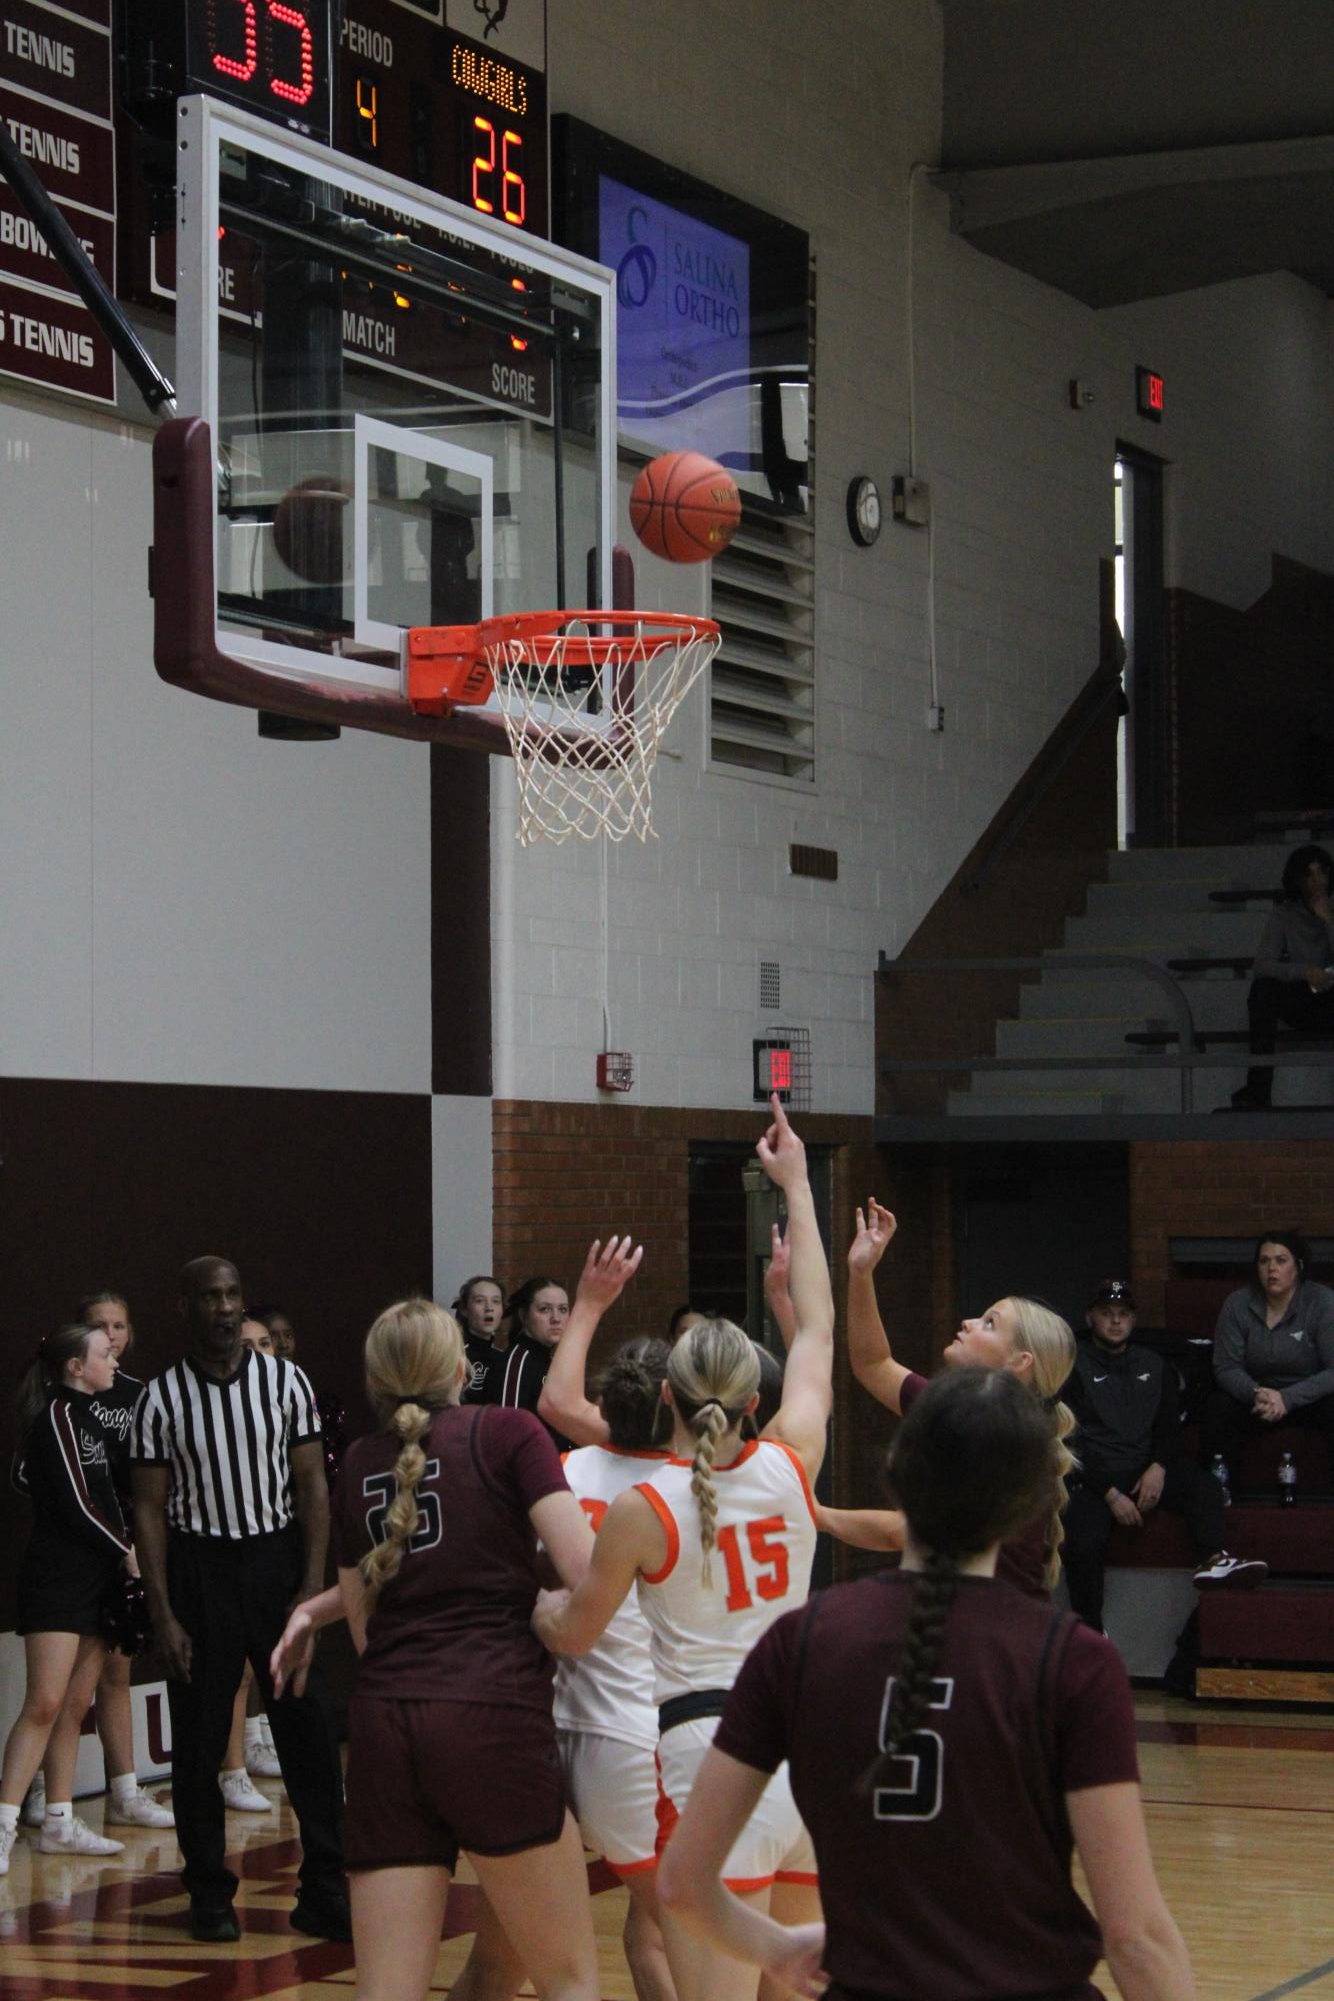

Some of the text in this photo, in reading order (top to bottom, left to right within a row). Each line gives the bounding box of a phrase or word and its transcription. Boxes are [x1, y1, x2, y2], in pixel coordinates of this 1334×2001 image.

[4, 20, 75, 78] TENNIS
[340, 19, 393, 68] PERIOD
[356, 79, 377, 147] 4
[7, 118, 80, 175] TENNIS
[472, 116, 525, 225] 26
[674, 243, 739, 300] SALINA
[343, 309, 396, 357] MATCH
[675, 284, 740, 338] ORTHO
[11, 313, 94, 368] TENNIS
[491, 363, 536, 405] SCORE
[363, 1458, 443, 1554] 25
[716, 1515, 789, 1613] 15
[873, 1676, 955, 1822] 5
